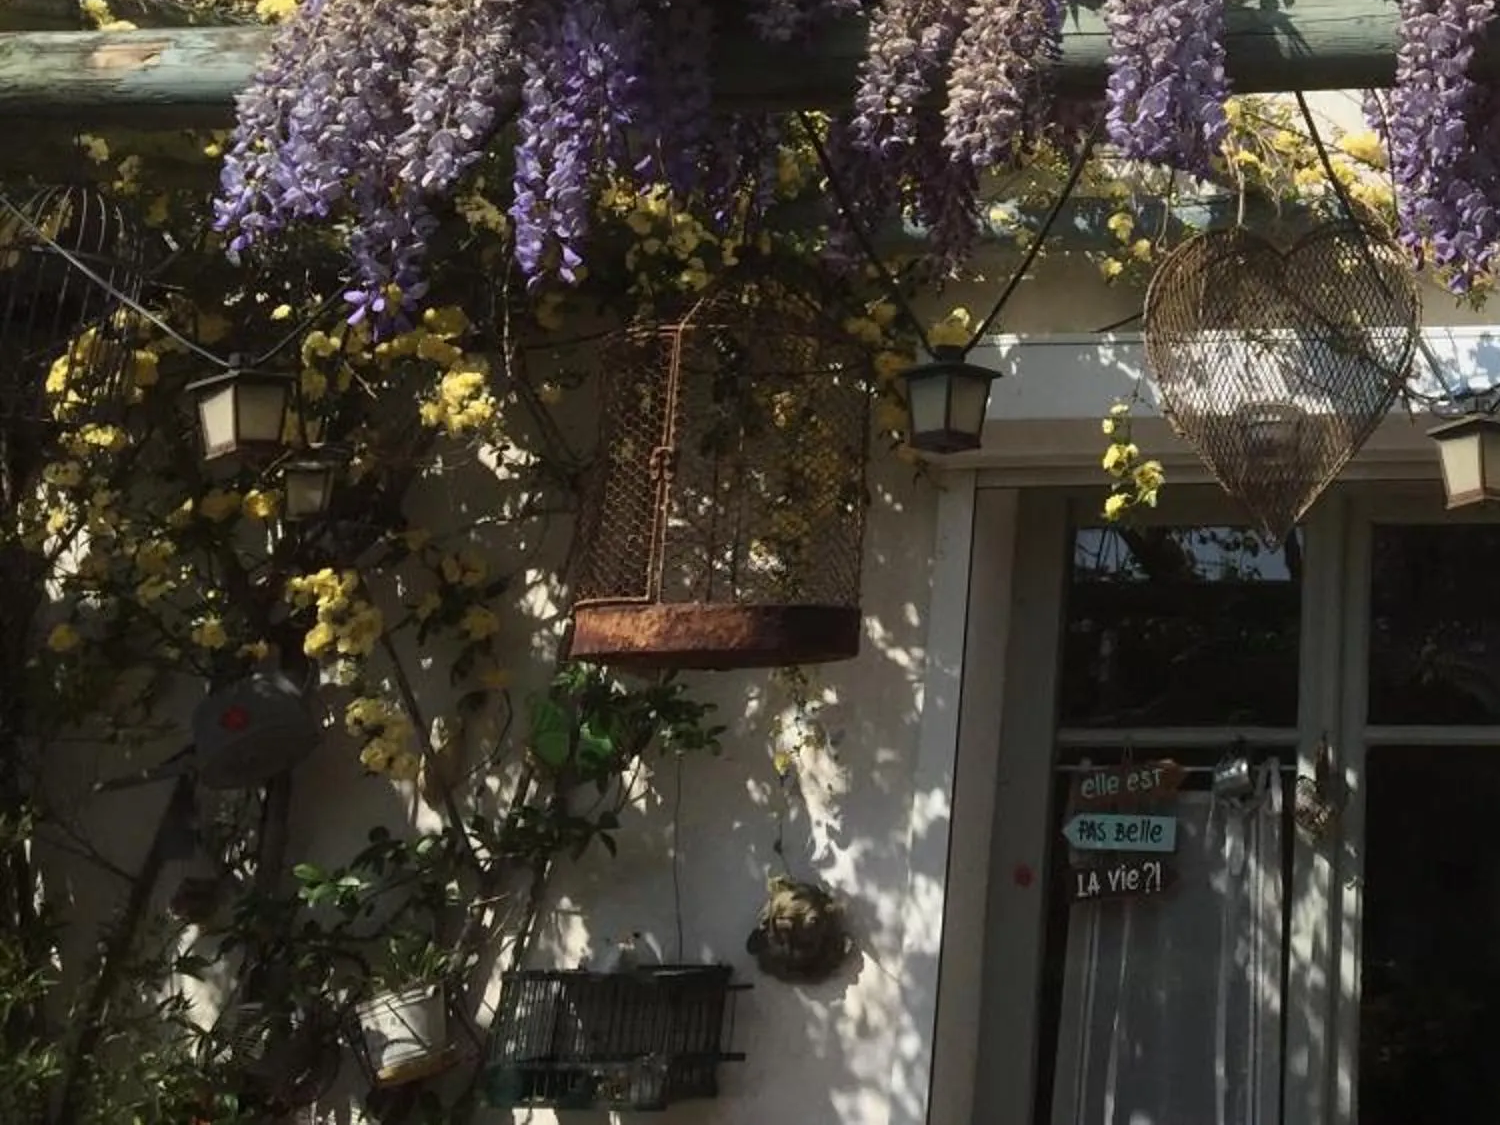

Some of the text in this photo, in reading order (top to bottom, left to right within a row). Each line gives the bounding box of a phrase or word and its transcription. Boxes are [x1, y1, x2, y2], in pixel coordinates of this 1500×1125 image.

[1080, 771, 1119, 799] elle
[1078, 819, 1106, 842] PAS
[1076, 870, 1101, 898] LA
